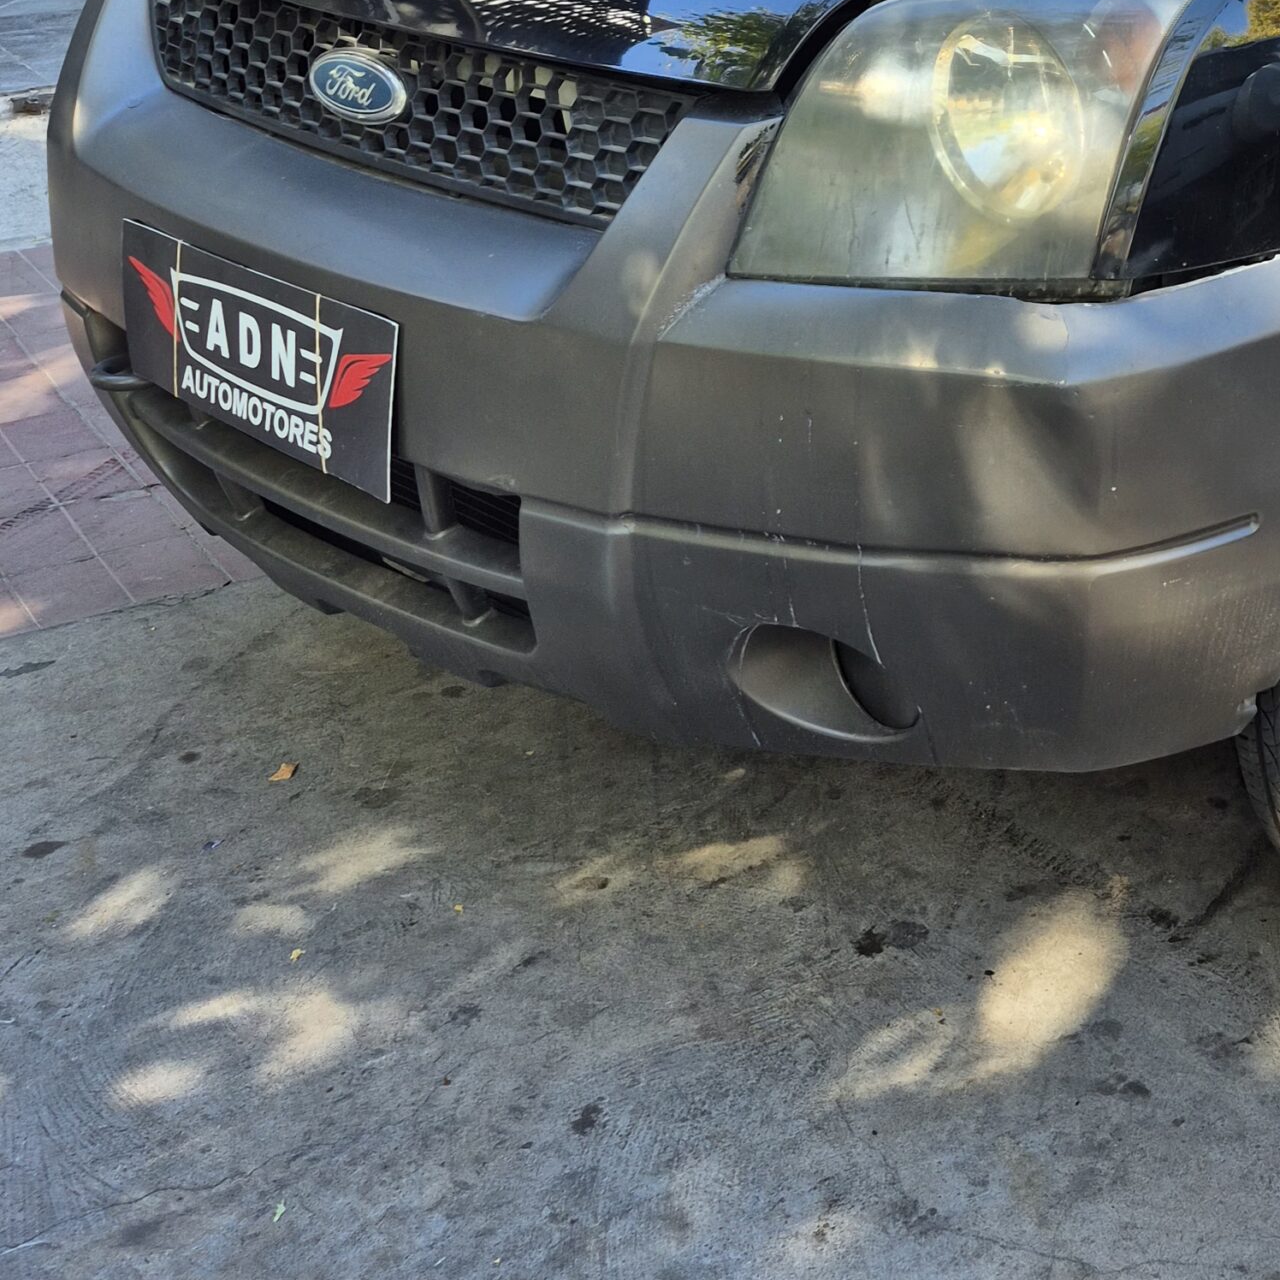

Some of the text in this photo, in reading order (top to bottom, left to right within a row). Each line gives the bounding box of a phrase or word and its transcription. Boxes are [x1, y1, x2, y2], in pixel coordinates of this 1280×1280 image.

[326, 64, 376, 106] Ford
[205, 298, 296, 388] ADN
[181, 365, 333, 460] AUTOMOTORES
